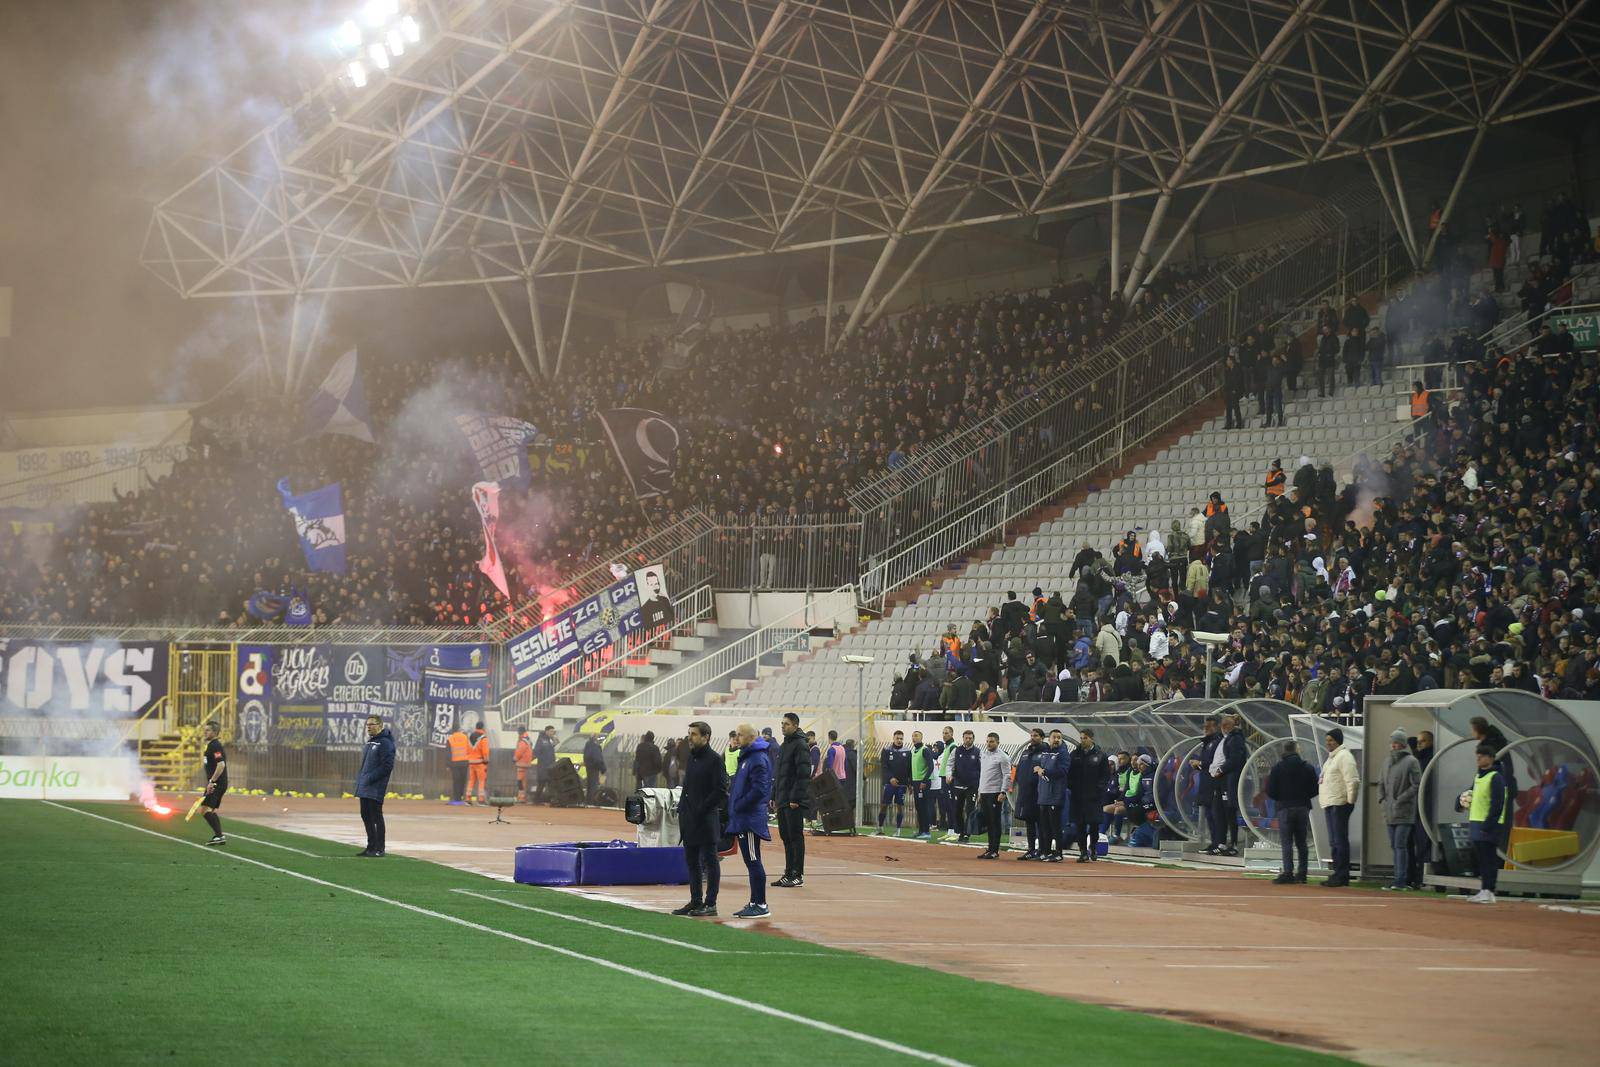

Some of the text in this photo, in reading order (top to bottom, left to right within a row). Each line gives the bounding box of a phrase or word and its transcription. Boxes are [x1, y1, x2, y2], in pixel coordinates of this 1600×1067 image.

[1568, 330, 1591, 342] XIT
[17, 453, 48, 472] 1992
[59, 451, 90, 470] 1993
[572, 582, 637, 623] ZA PR
[510, 617, 573, 666] SESVETE
[0, 646, 154, 712] OYS
[429, 681, 482, 700] Karlovac
[327, 703, 394, 717] BAD BLUE BOYS
[0, 761, 80, 787] banka
